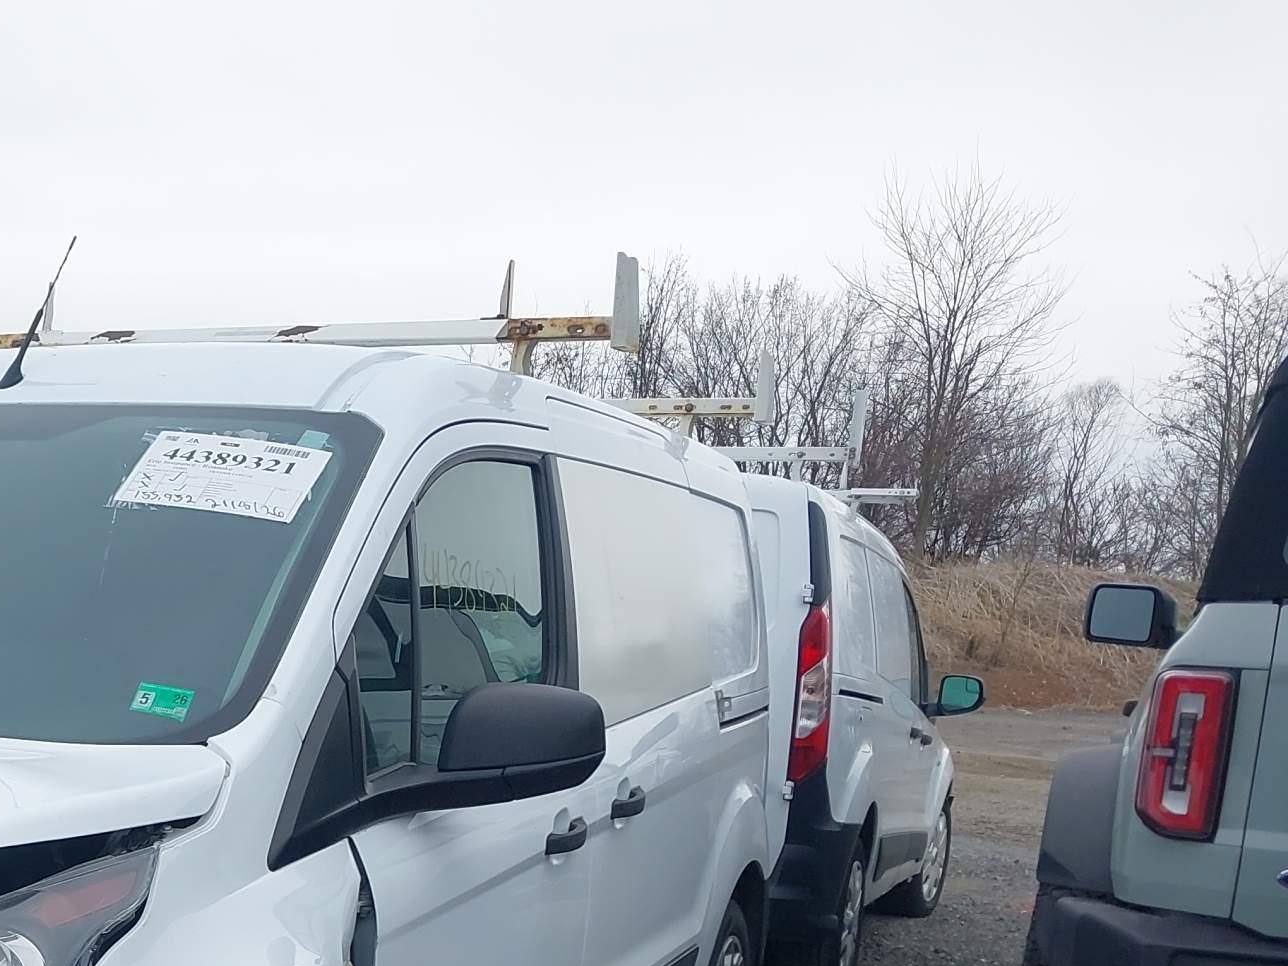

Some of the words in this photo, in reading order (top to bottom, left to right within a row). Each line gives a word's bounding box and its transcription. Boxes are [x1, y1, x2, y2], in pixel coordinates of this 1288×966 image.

[163, 447, 297, 475] 44389321
[139, 692, 151, 705] 5
[172, 694, 188, 705] 26
